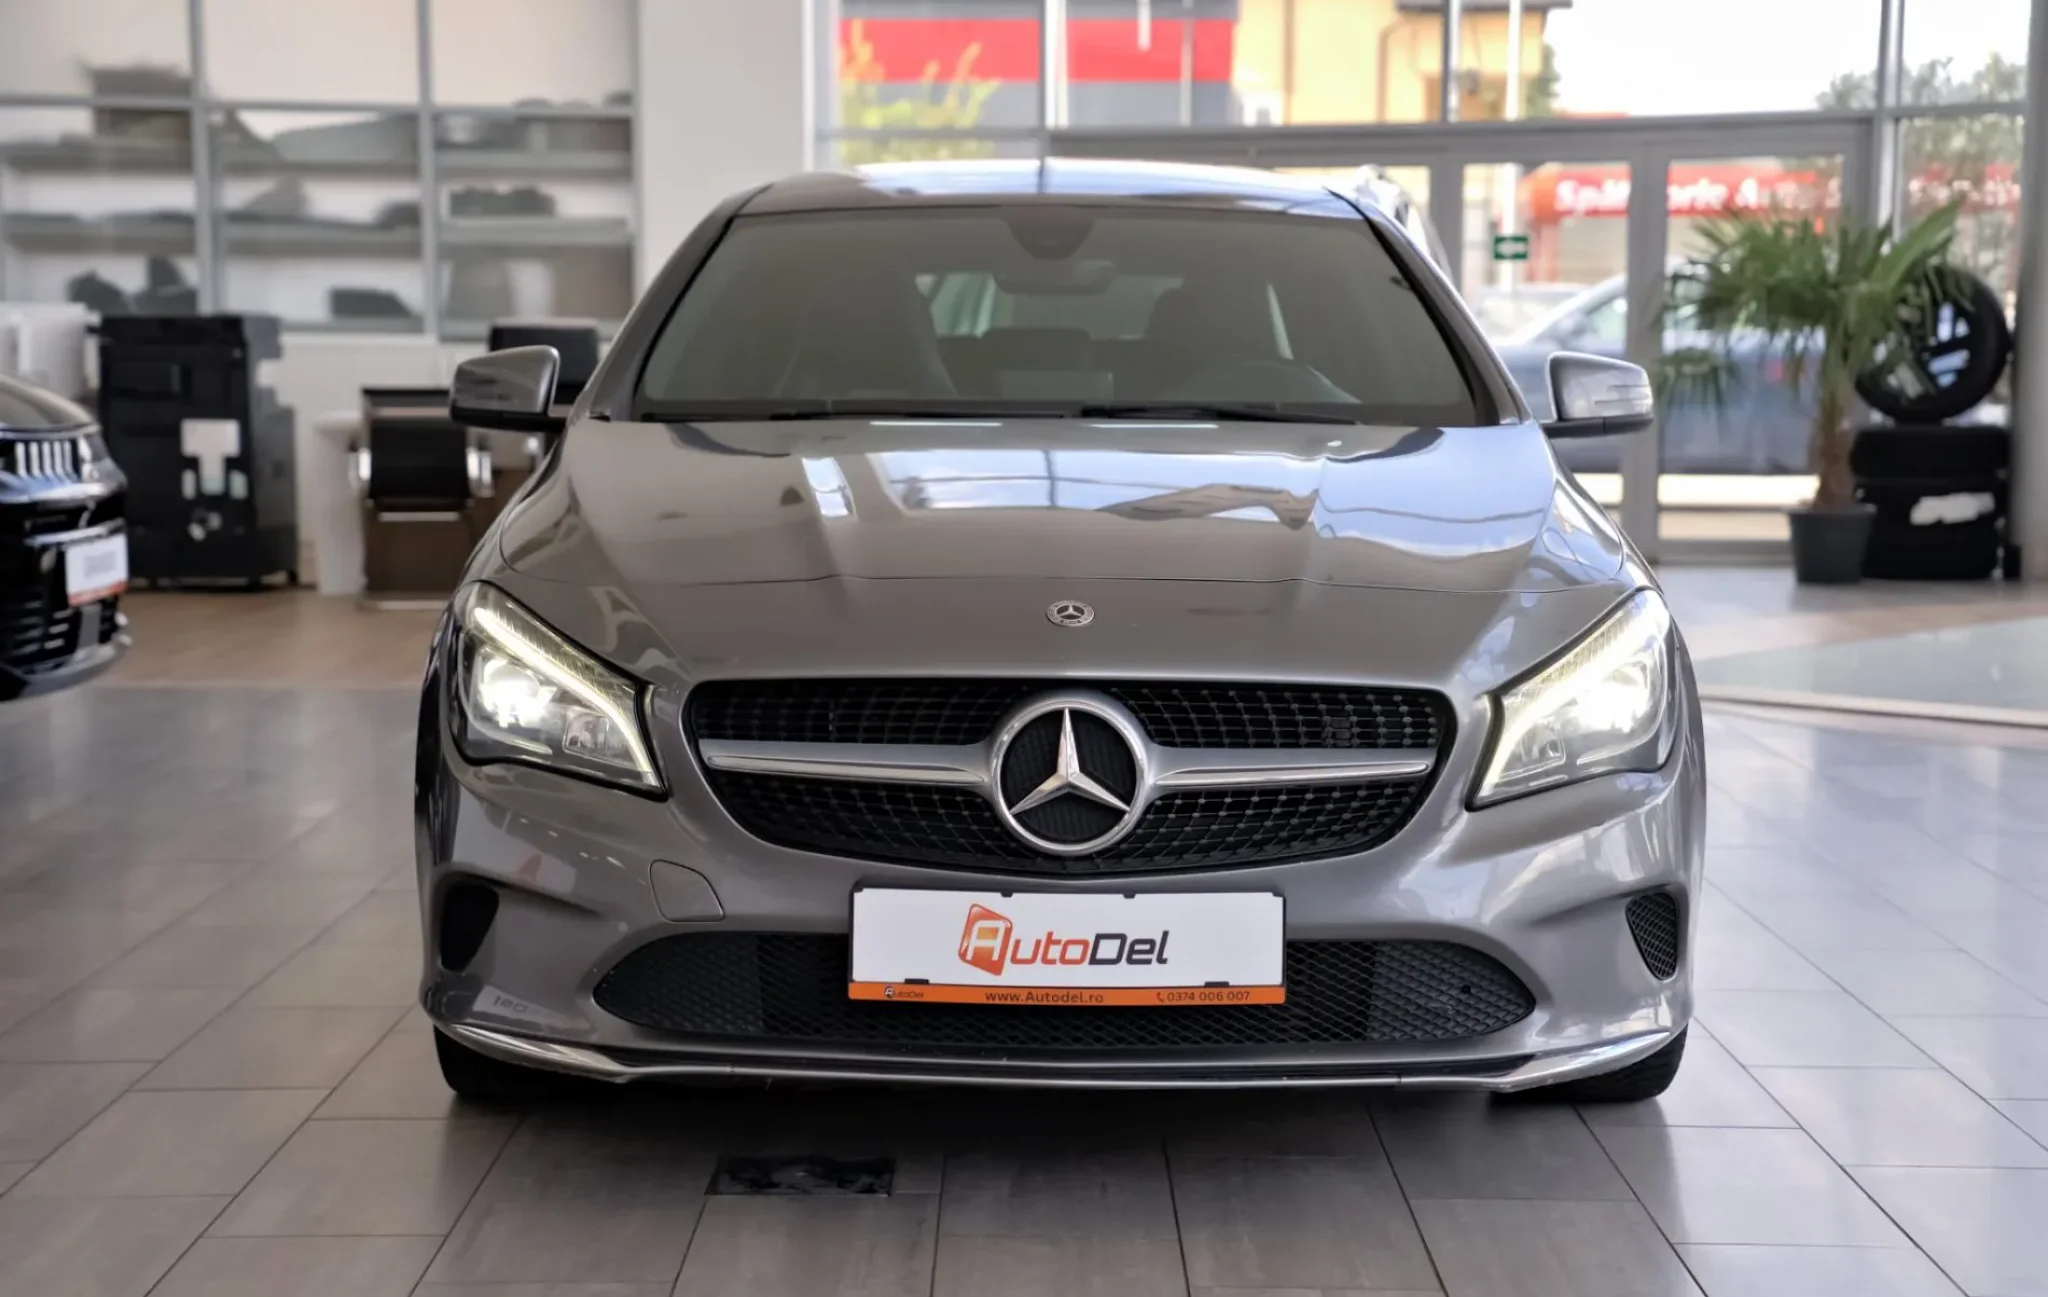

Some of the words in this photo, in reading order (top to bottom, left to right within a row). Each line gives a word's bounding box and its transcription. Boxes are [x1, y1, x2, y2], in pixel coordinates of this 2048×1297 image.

[964, 917, 1170, 967] AutoDel
[985, 991, 1105, 1004] www.Autodel.ro
[1166, 991, 1196, 1002] 0374
[1199, 991, 1225, 1002] 006
[1226, 991, 1251, 1002] 007
